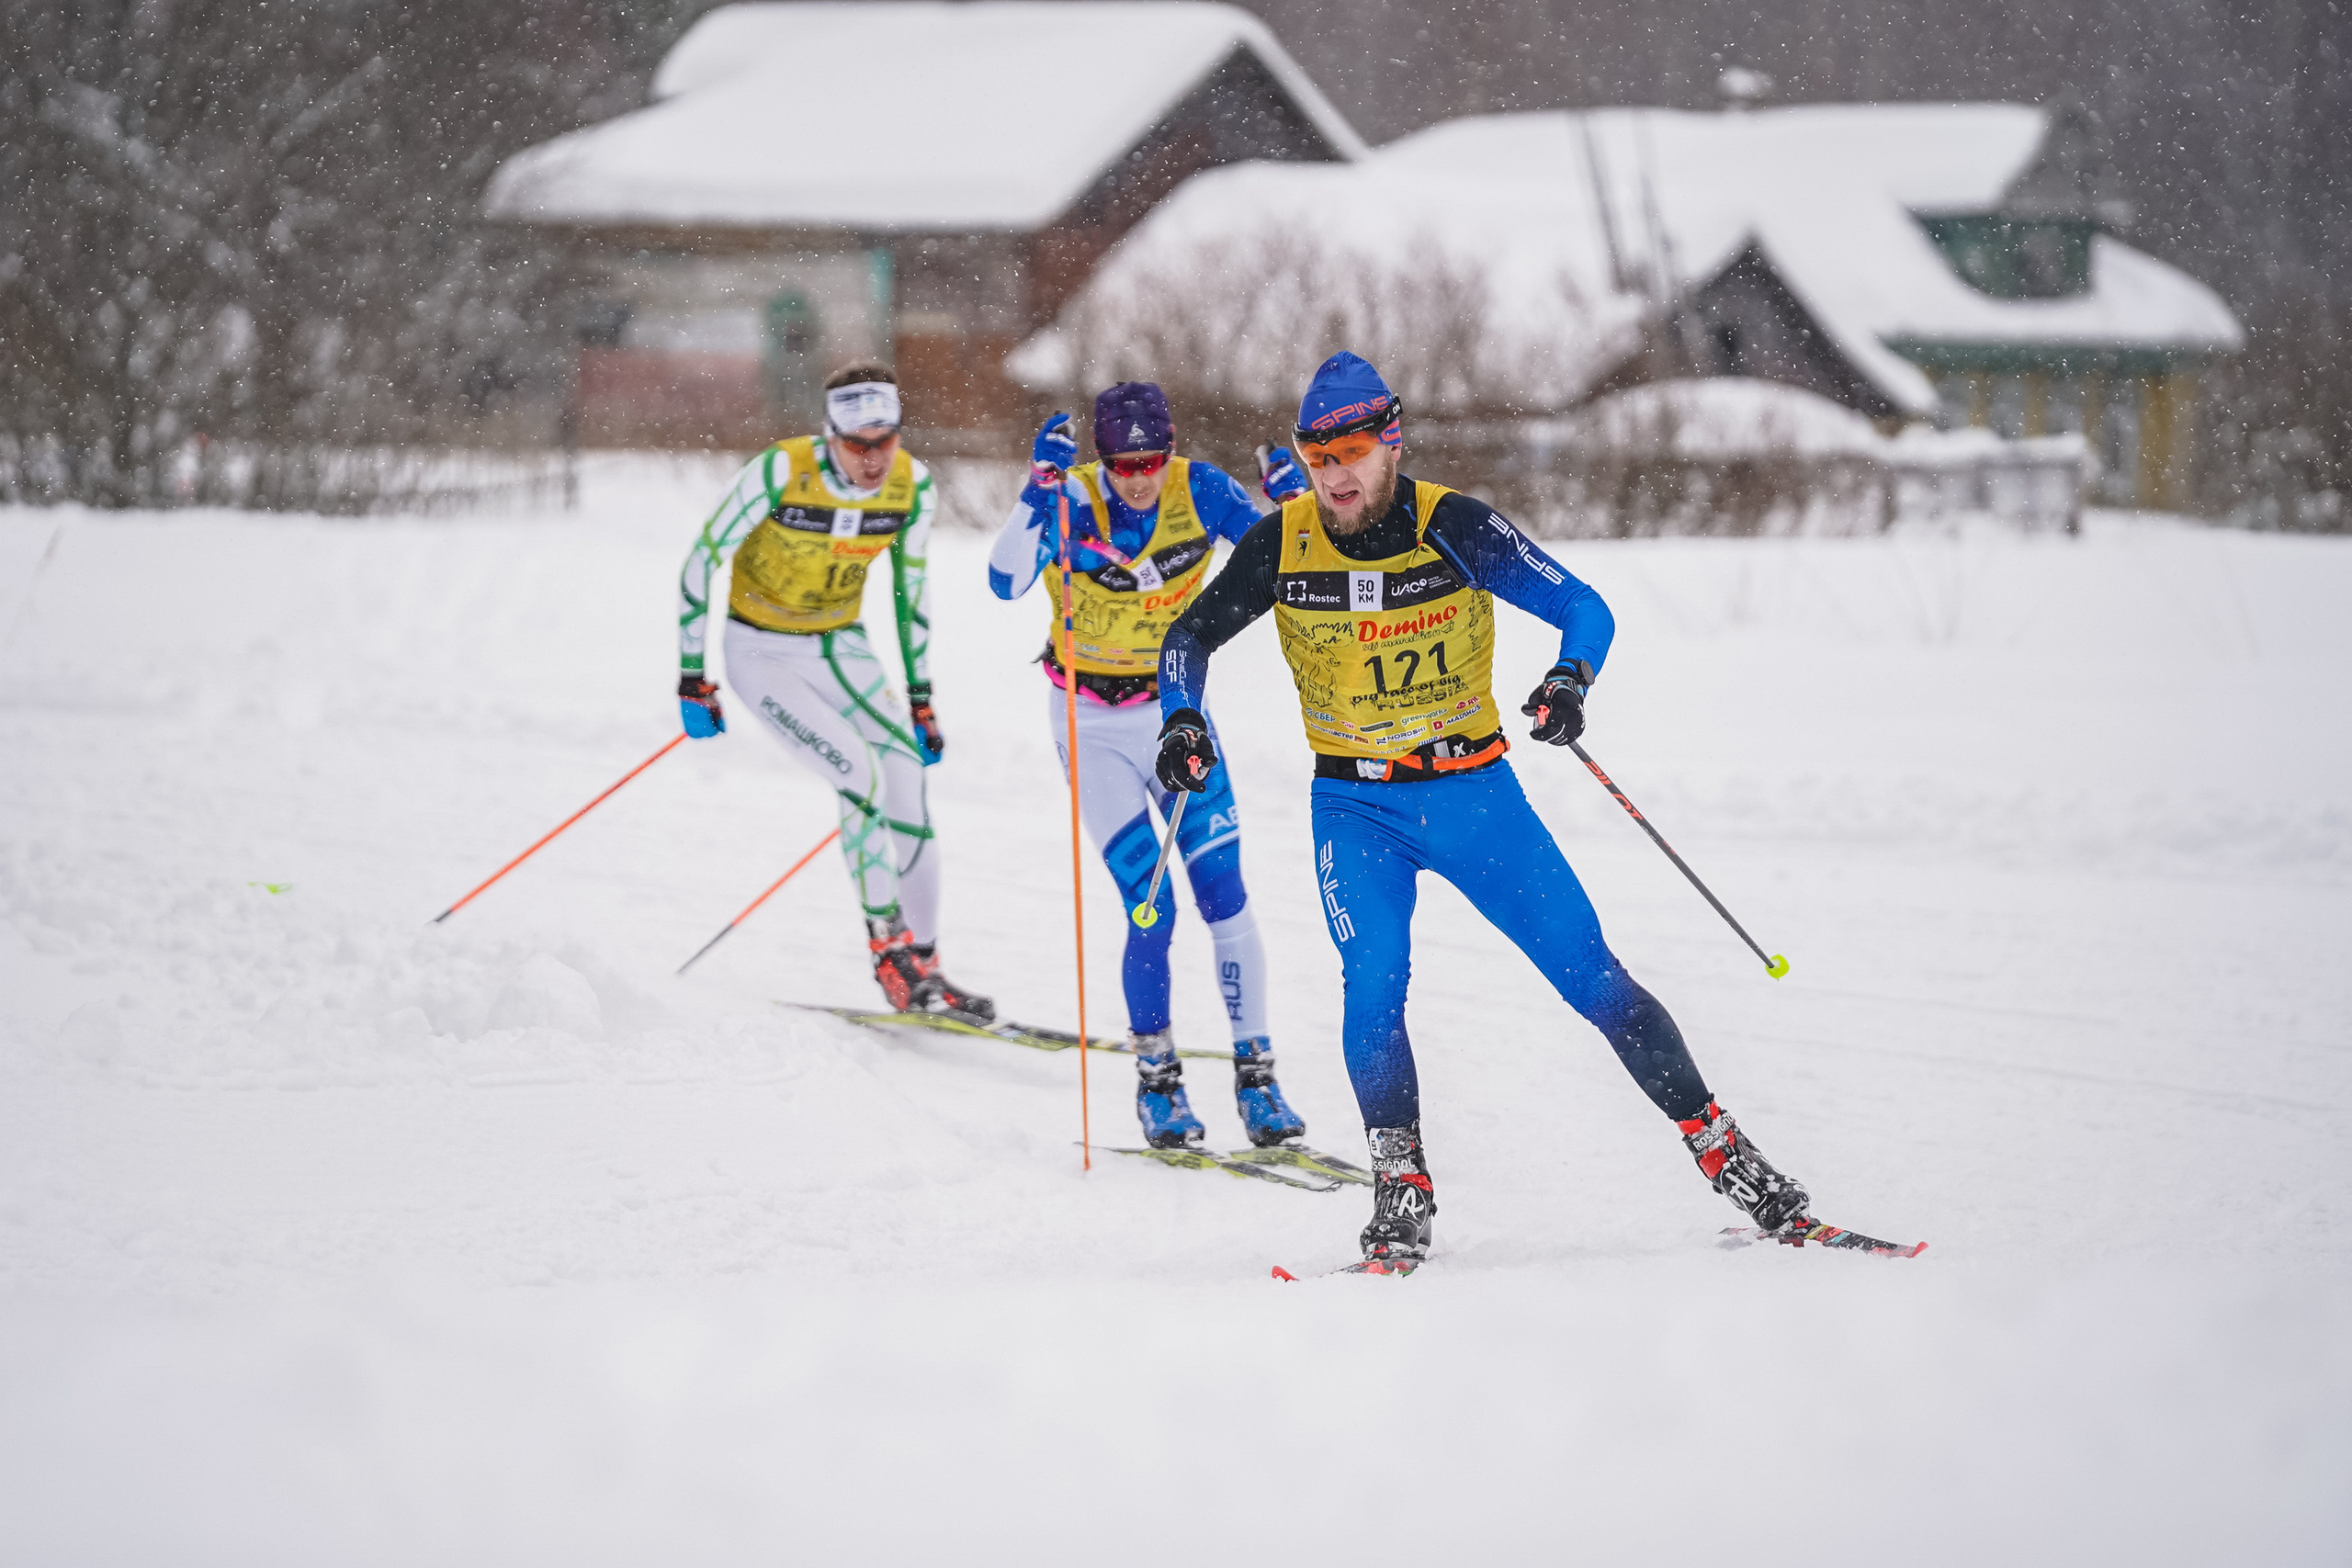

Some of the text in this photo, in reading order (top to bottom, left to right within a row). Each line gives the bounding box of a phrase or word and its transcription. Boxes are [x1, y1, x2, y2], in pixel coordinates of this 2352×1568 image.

[1311, 396, 1388, 431] SPINE
[1487, 512, 1566, 586] SPINE
[1357, 579, 1374, 592] 50
[1391, 581, 1420, 597] UAC
[1308, 593, 1341, 604] Rostec
[1358, 593, 1374, 604] KM
[1357, 604, 1458, 643] Demino
[1165, 649, 1177, 683] SCF
[1363, 640, 1450, 694] 121
[1314, 711, 1336, 722] СБЕР
[1401, 708, 1448, 726] greenworks
[1446, 704, 1482, 725] MADSHUS
[1387, 726, 1426, 740] NORDSKI
[1319, 839, 1356, 942] SPINE
[1221, 960, 1243, 1021] RUS
